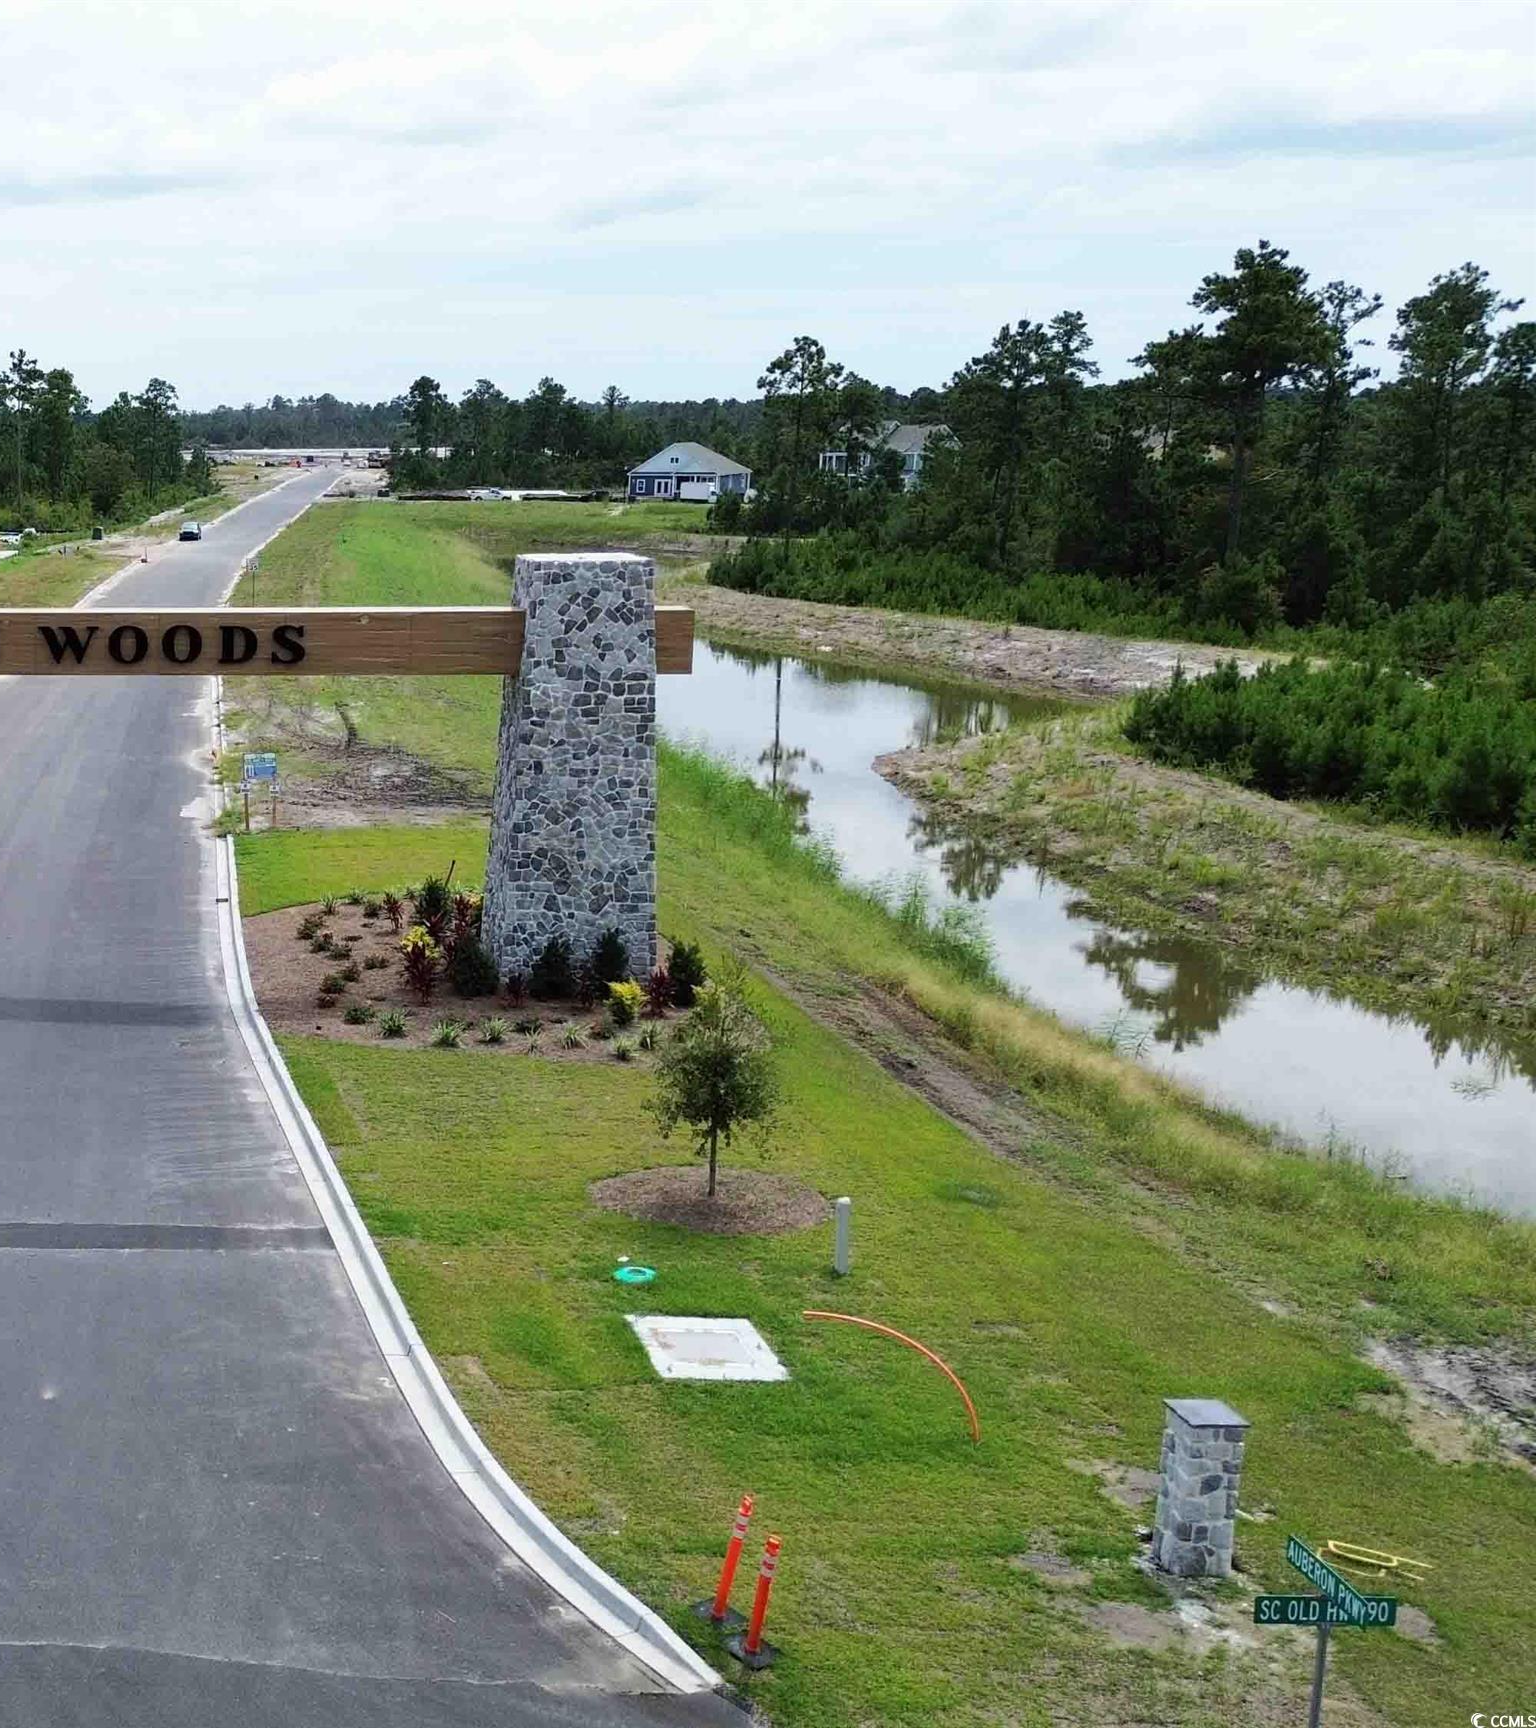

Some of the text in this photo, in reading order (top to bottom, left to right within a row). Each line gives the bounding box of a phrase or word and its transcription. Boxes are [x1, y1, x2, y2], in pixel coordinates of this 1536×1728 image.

[37, 624, 306, 664] WOODS
[1287, 1540, 1367, 1625] AUBERON PKWY
[1259, 1600, 1281, 1621] SC
[1288, 1600, 1320, 1621] OLD
[1367, 1601, 1390, 1622] 90
